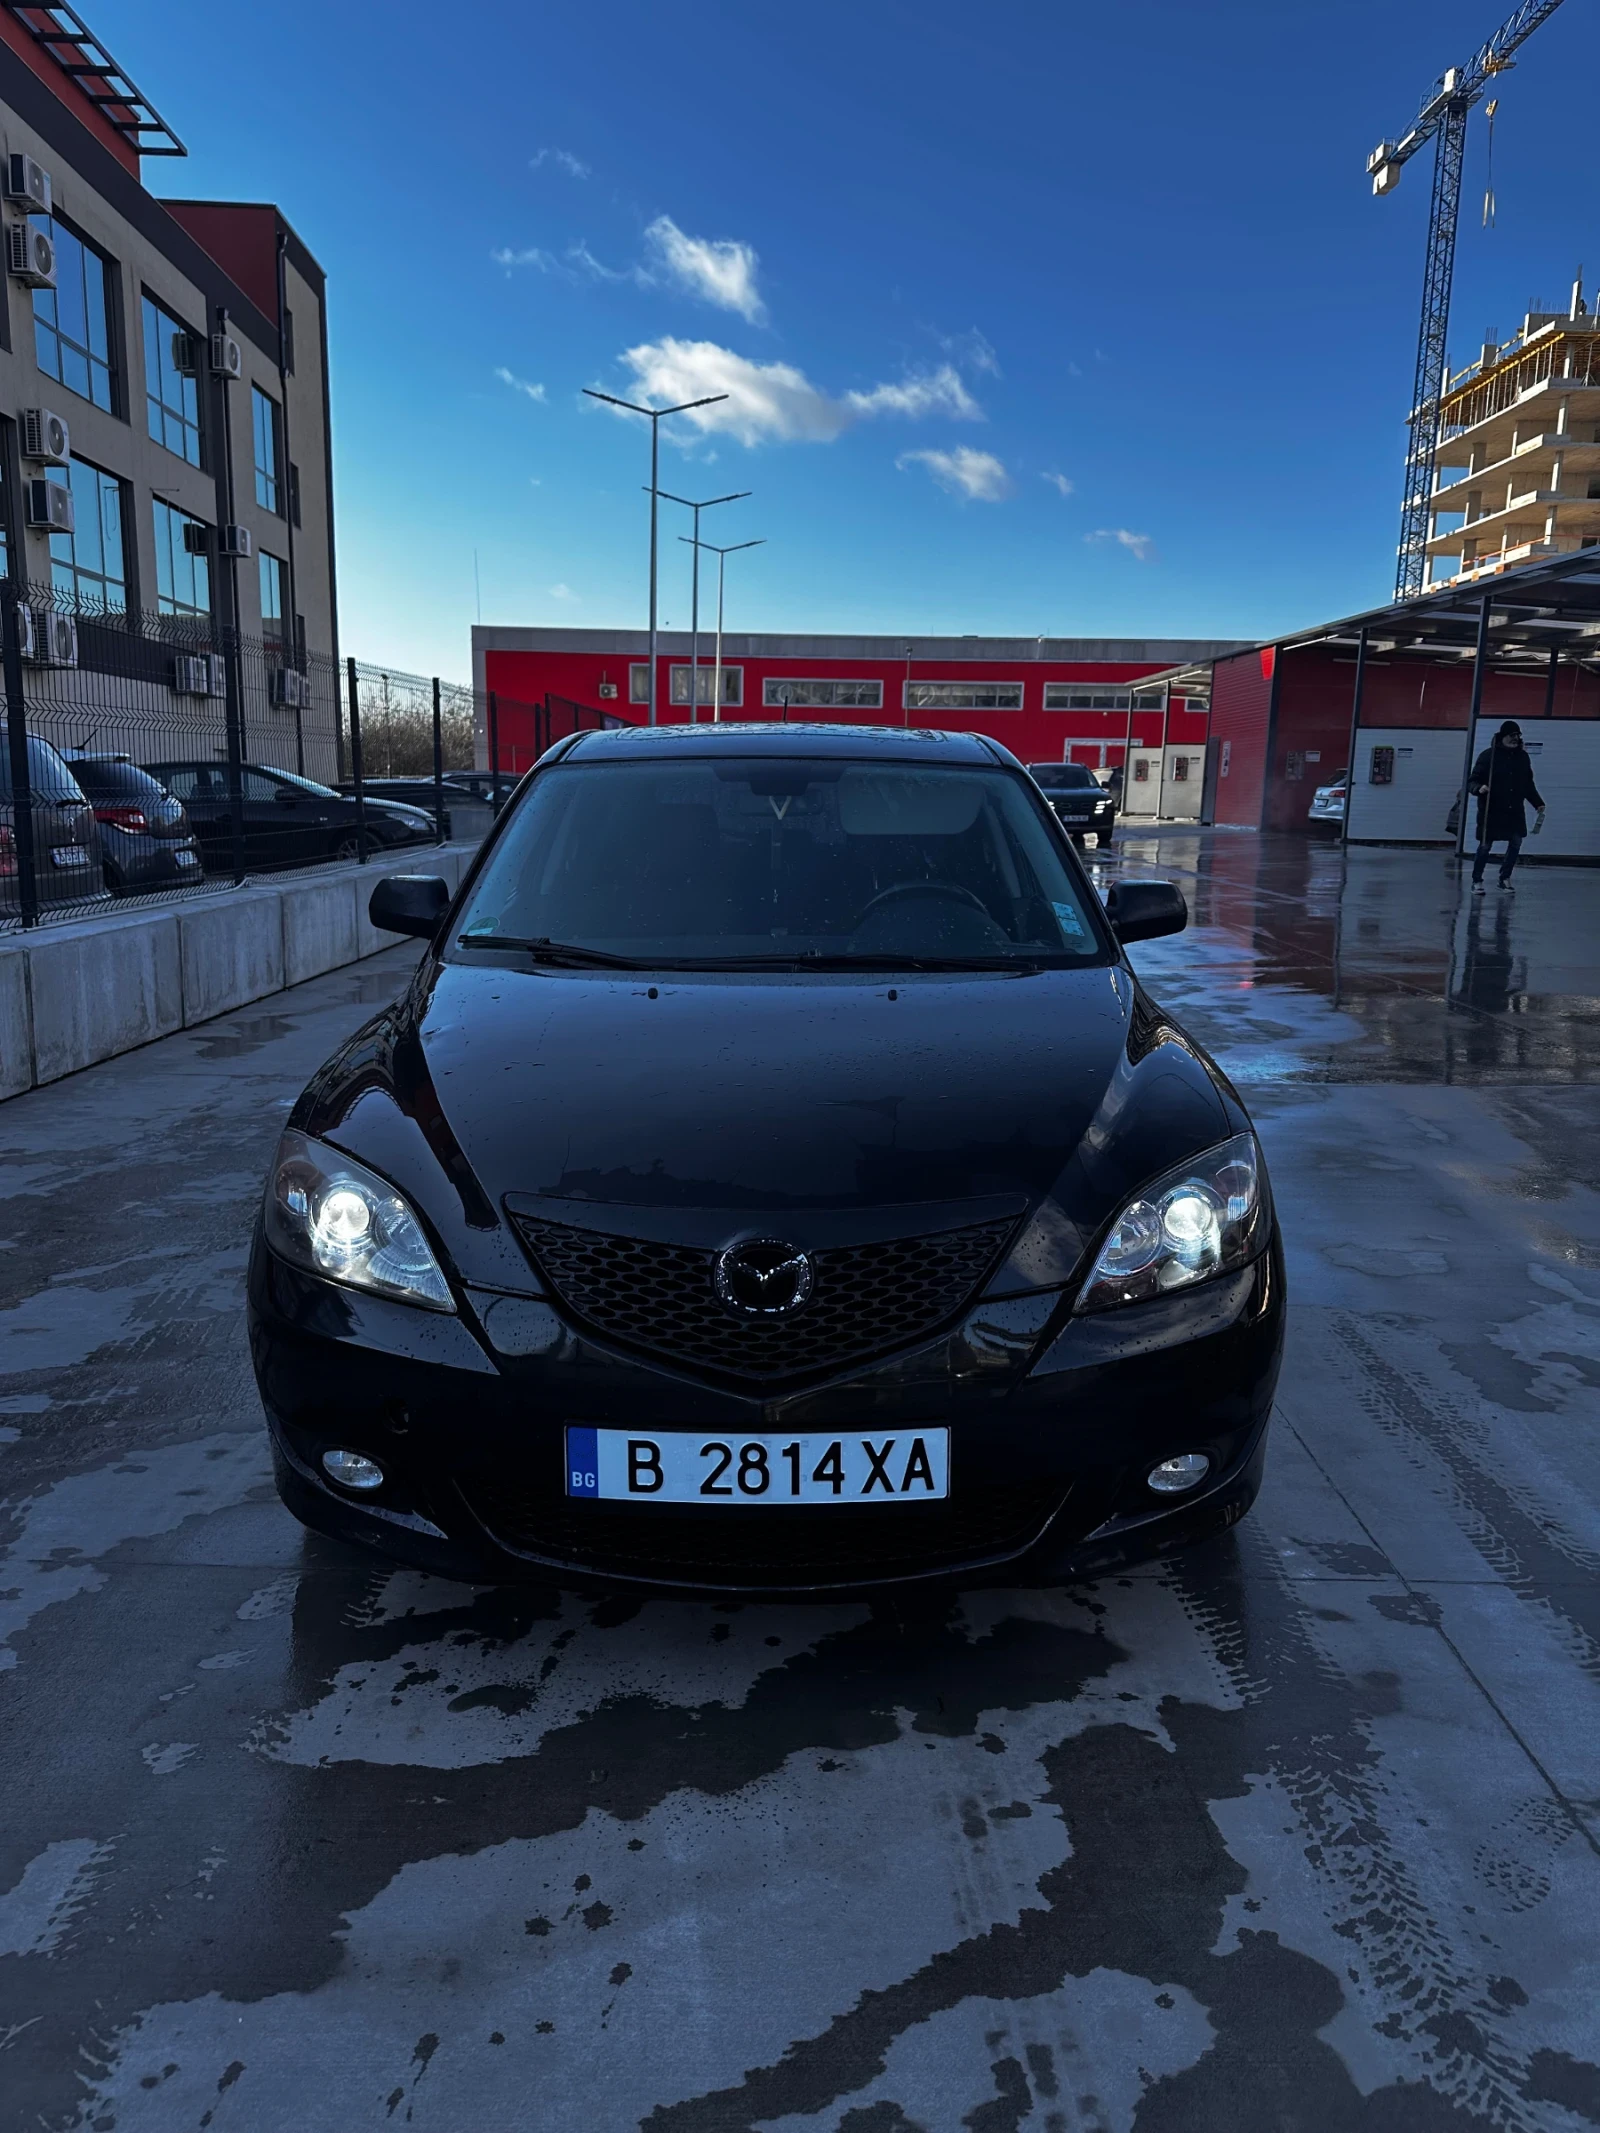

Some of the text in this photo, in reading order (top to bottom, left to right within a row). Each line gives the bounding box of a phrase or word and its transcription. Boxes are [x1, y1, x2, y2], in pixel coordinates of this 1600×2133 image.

[572, 1471, 595, 1488] BG
[628, 1437, 935, 1495] B 2814 XA
